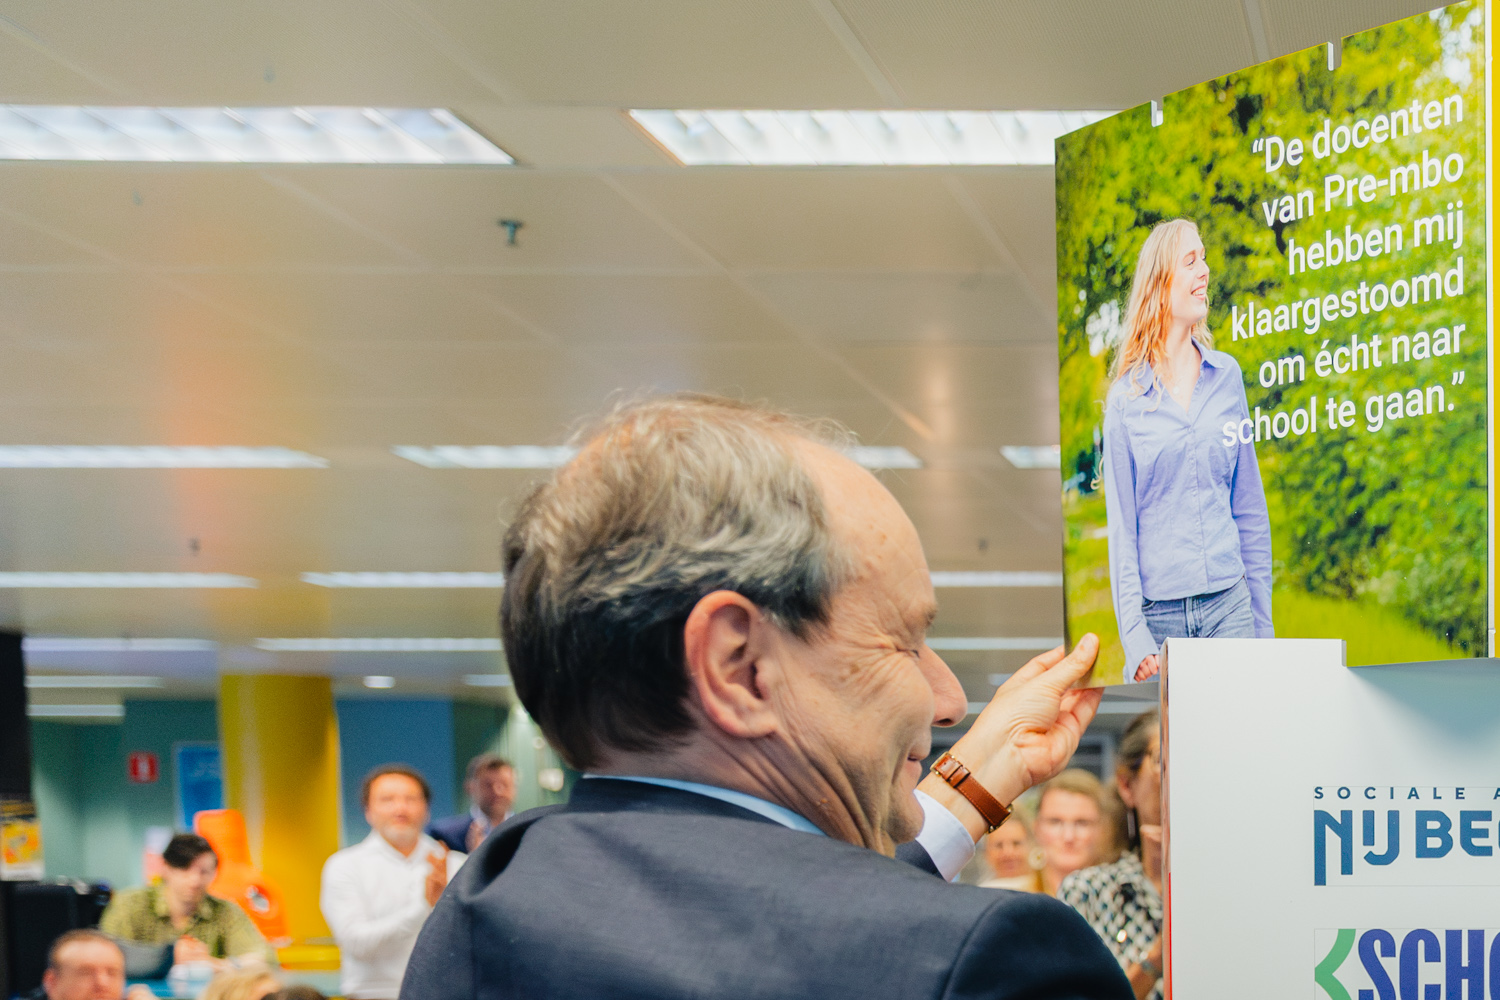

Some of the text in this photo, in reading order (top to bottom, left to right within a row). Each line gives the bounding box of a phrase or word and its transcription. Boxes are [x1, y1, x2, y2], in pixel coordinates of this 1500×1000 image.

[1252, 94, 1463, 173] “De docenten
[1262, 150, 1464, 227] van Pre-mbo
[1288, 200, 1464, 275] hebben mij
[1231, 256, 1464, 341] klaargestoomd
[1258, 324, 1466, 388] om écht naar
[1221, 371, 1466, 447] school te gaan.”
[1314, 786, 1466, 800] SOCIALE
